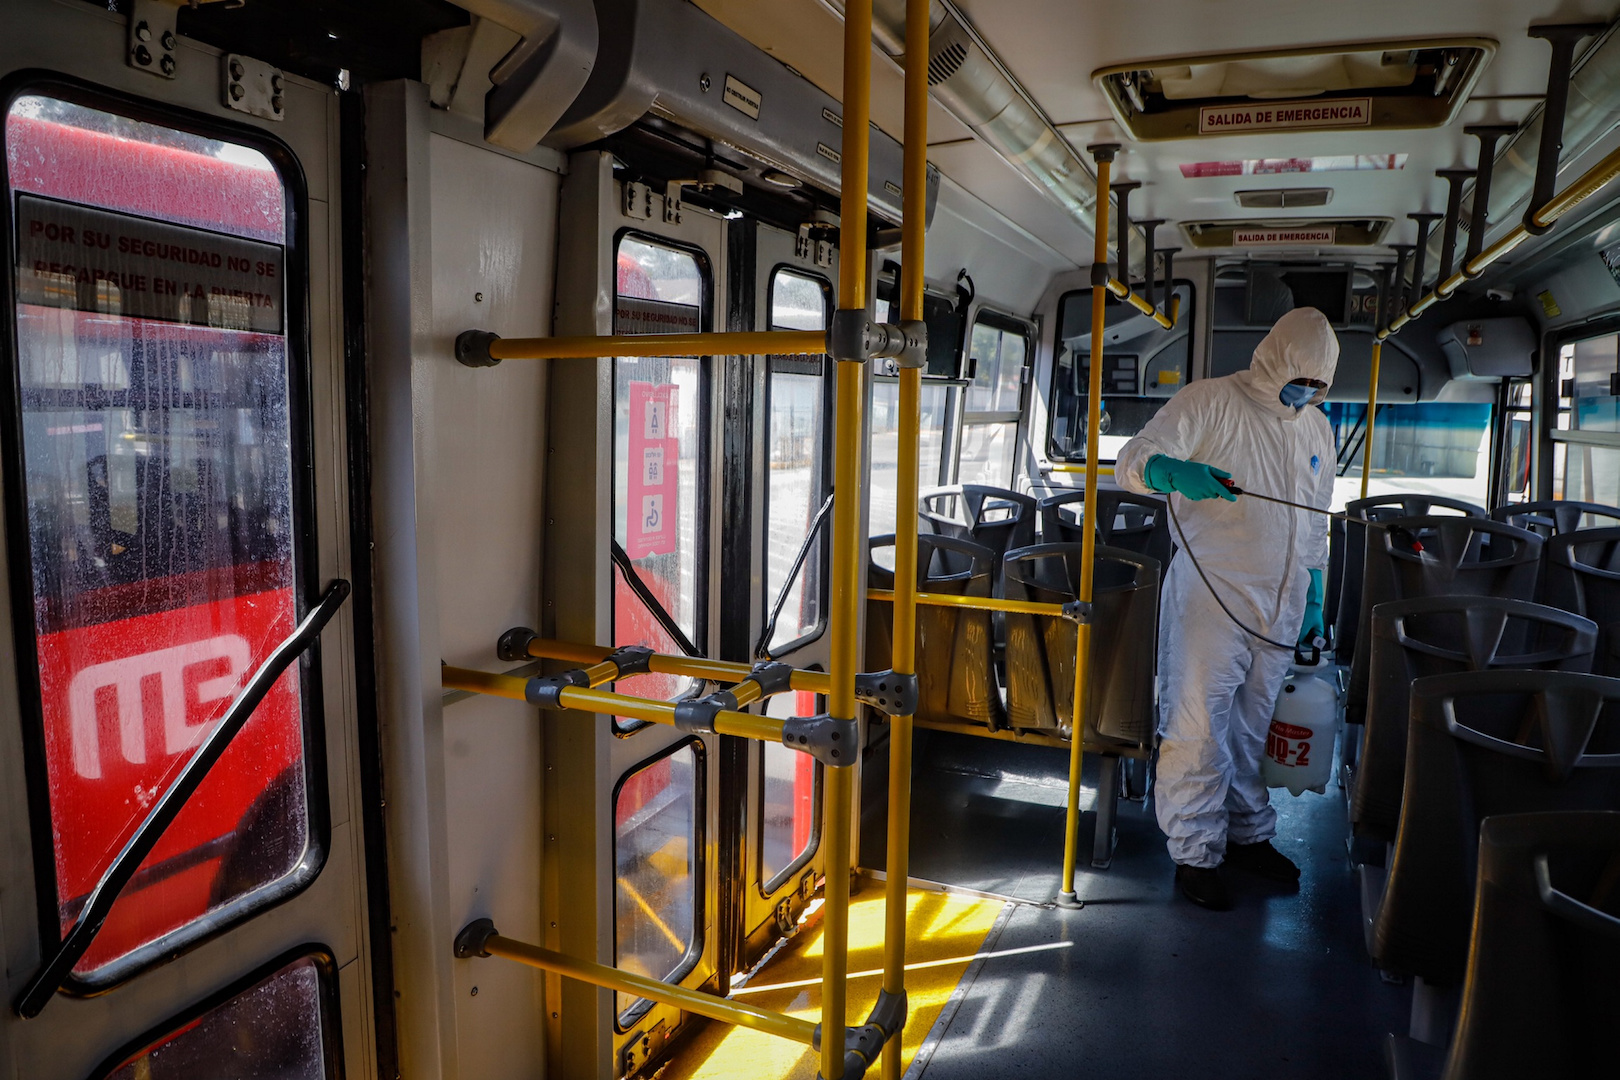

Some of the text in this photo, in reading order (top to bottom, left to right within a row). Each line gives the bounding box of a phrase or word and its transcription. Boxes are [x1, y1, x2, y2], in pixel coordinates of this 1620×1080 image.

[1207, 106, 1362, 126] SALIDA DE EMERGENCIA
[1280, 232, 1330, 241] EMERGENCIA
[30, 220, 276, 278] POR SU SEGURIDAD NO SE
[33, 260, 274, 309] RECARGUE EN LA PUERTA
[632, 310, 640, 320] SU
[642, 312, 678, 324] SEGURIDAD
[678, 317, 687, 325] NO
[688, 318, 696, 326] SE
